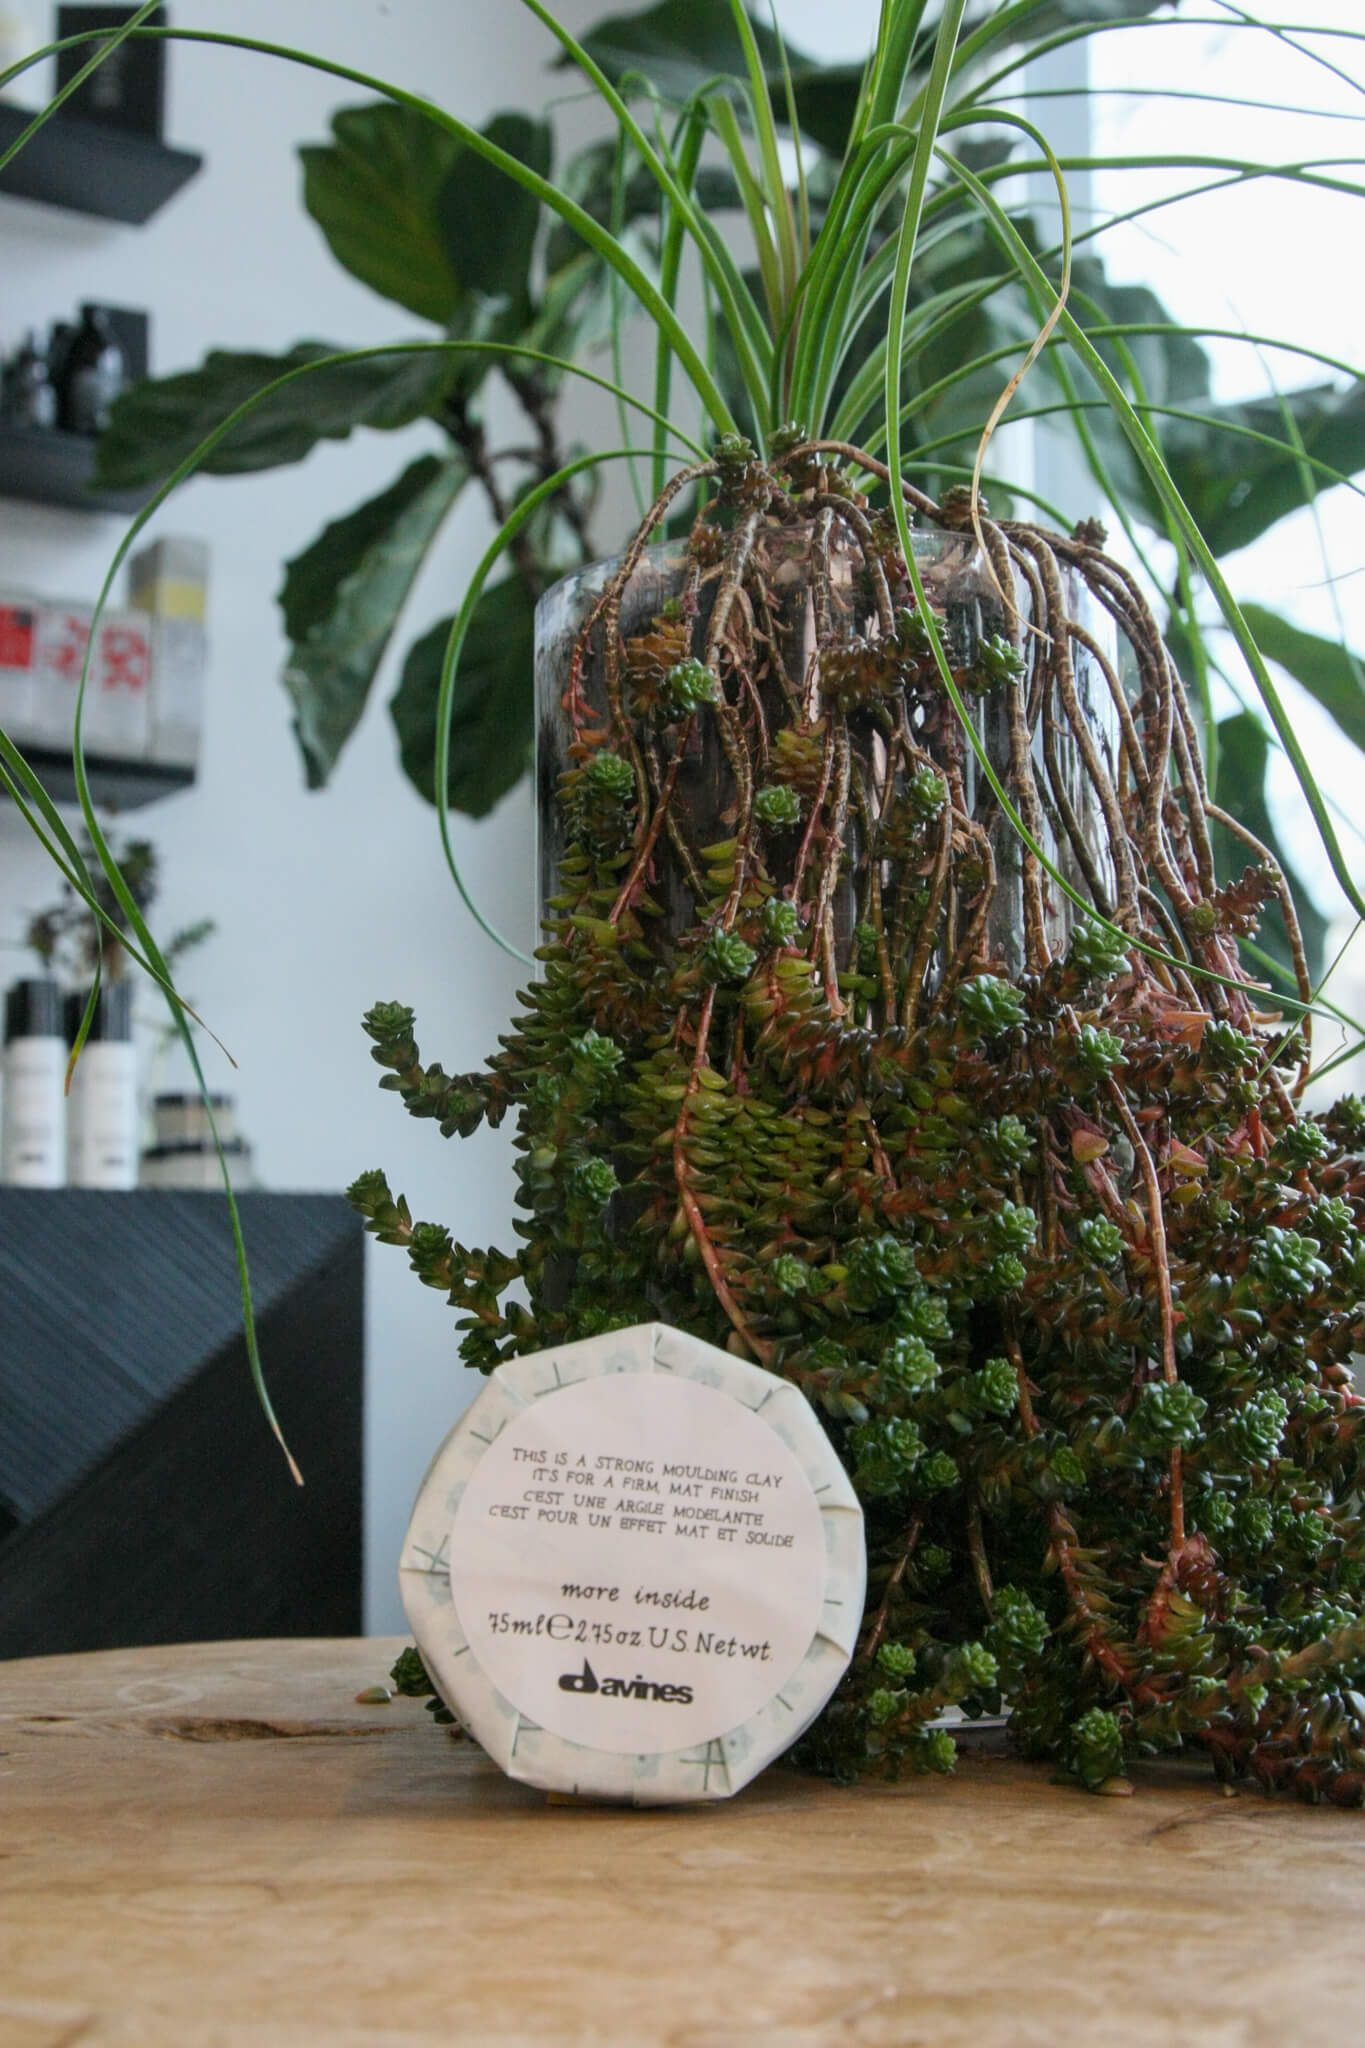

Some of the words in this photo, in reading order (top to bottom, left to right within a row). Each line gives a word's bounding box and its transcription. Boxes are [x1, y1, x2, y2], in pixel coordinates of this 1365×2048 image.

[513, 1448, 547, 1464] THIS
[555, 1452, 568, 1466] IS
[576, 1454, 587, 1467] A
[595, 1456, 655, 1473] STRONG
[662, 1464, 738, 1483] MOULDING
[745, 1473, 783, 1489] CLAY
[565, 1471, 595, 1486] FOR
[603, 1475, 614, 1488] A
[669, 1483, 703, 1498] MAT
[710, 1487, 760, 1503] FINISH
[537, 1508, 579, 1525] POUR
[588, 1513, 612, 1528] UN
[620, 1517, 667, 1534] EFFET
[675, 1524, 710, 1539] MAT
[717, 1527, 738, 1542] ET
[745, 1530, 795, 1548] SOLIDE
[573, 1493, 607, 1509] UNE
[615, 1499, 665, 1516] ARGILE
[672, 1505, 764, 1527] MODELANTE
[561, 1583, 620, 1602] more
[634, 1585, 710, 1611] inside
[558, 1656, 694, 1705] davines
